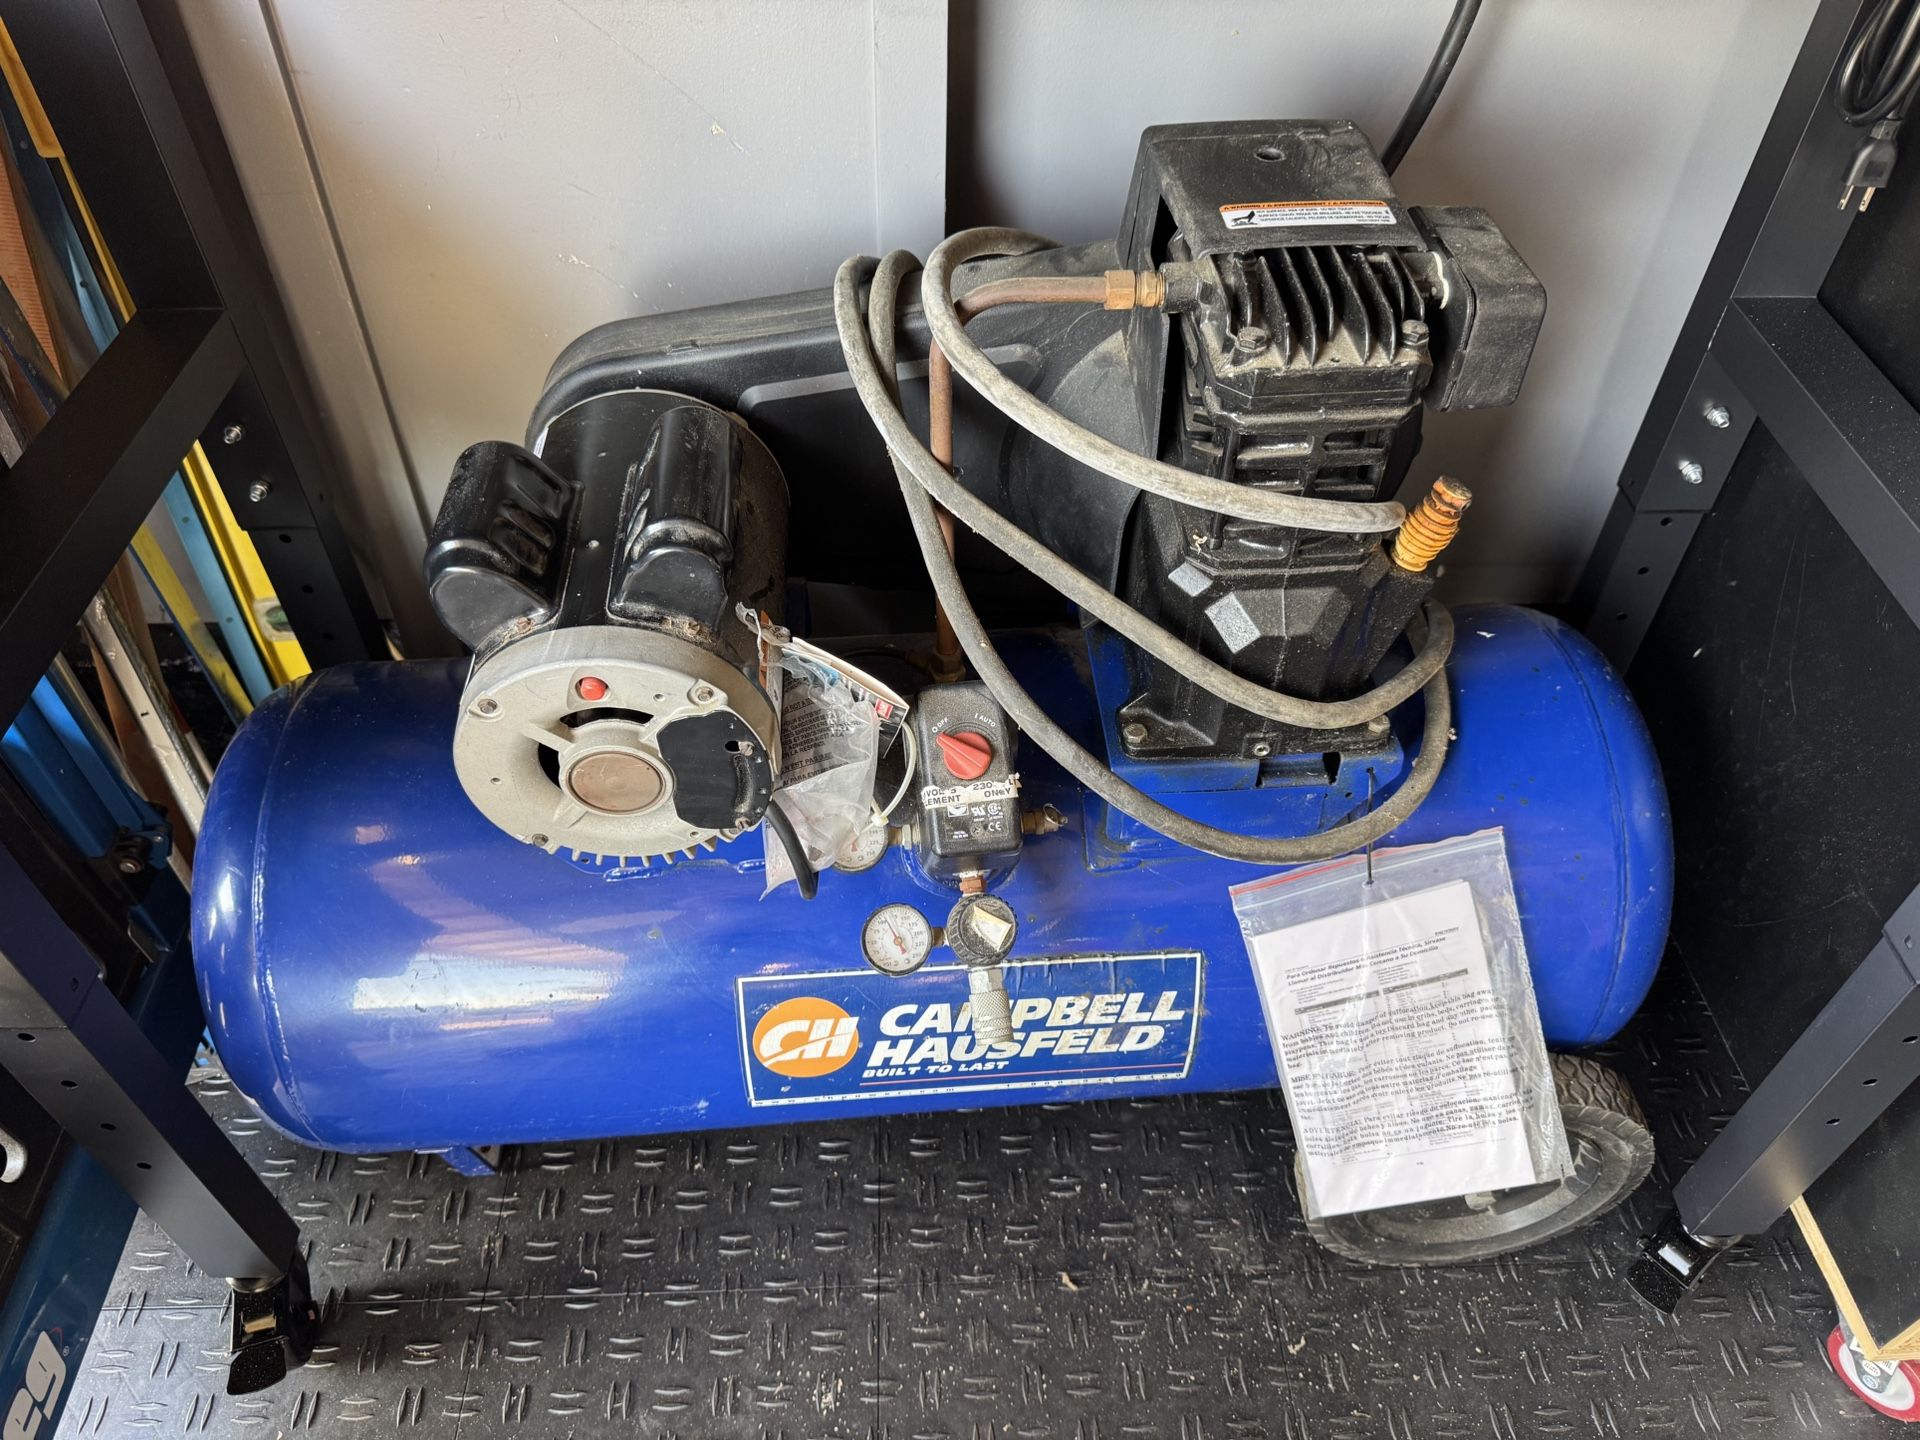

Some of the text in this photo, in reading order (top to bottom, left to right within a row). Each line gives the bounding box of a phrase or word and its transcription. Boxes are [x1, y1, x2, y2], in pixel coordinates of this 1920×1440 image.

[937, 717, 949, 728] OFF
[979, 715, 996, 728] AUTO
[973, 781, 993, 791] 230
[925, 794, 961, 806] EMENT
[867, 1024, 1167, 1068] HAUSFELD
[862, 1061, 1009, 1078] BUILT TO LAST
